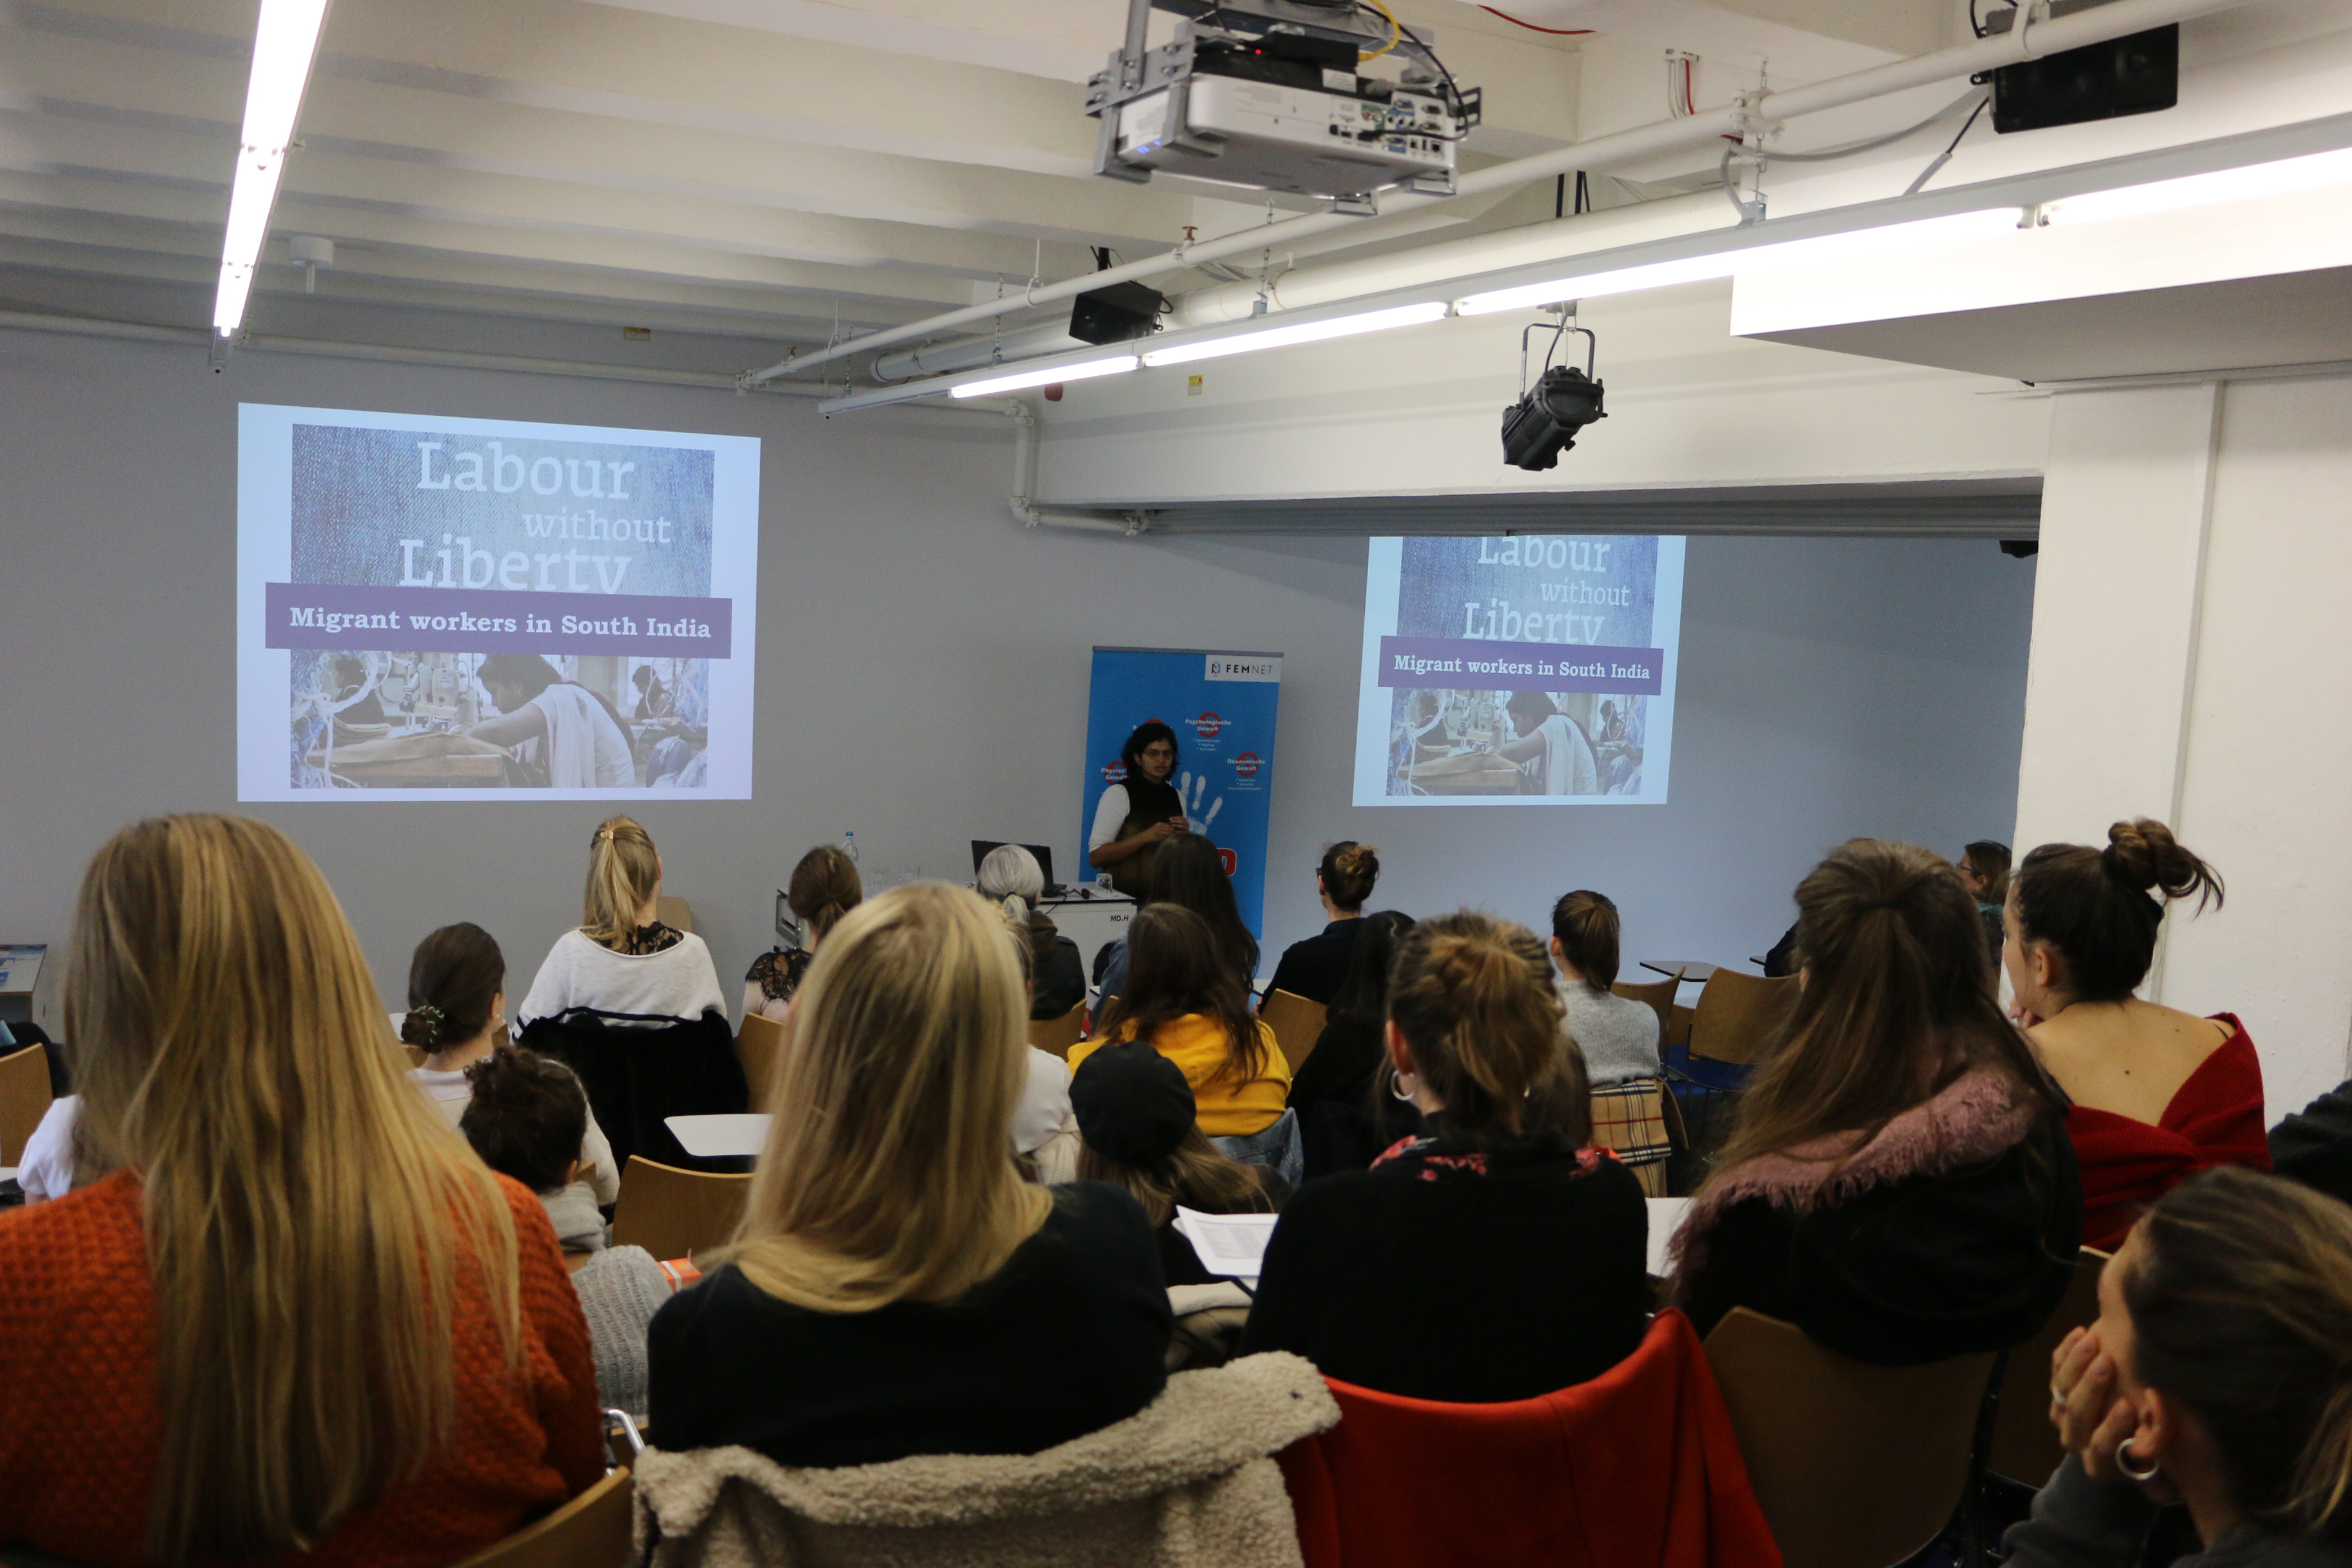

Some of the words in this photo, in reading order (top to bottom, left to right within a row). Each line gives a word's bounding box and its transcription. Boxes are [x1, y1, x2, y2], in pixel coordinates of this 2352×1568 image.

[417, 442, 634, 499] Labour
[522, 507, 671, 544] without
[1478, 535, 1611, 573] Labour
[1540, 578, 1630, 607] without
[290, 607, 400, 633] Migrant
[409, 611, 517, 632] workers
[526, 613, 553, 633] in
[562, 615, 638, 636] South
[647, 618, 712, 638] India
[1226, 664, 1273, 674] FEMNET
[1393, 654, 1462, 675] Migrant
[1467, 658, 1533, 675] workers
[1538, 660, 1554, 676] in
[1559, 661, 1606, 678] South
[1611, 663, 1651, 680] India
